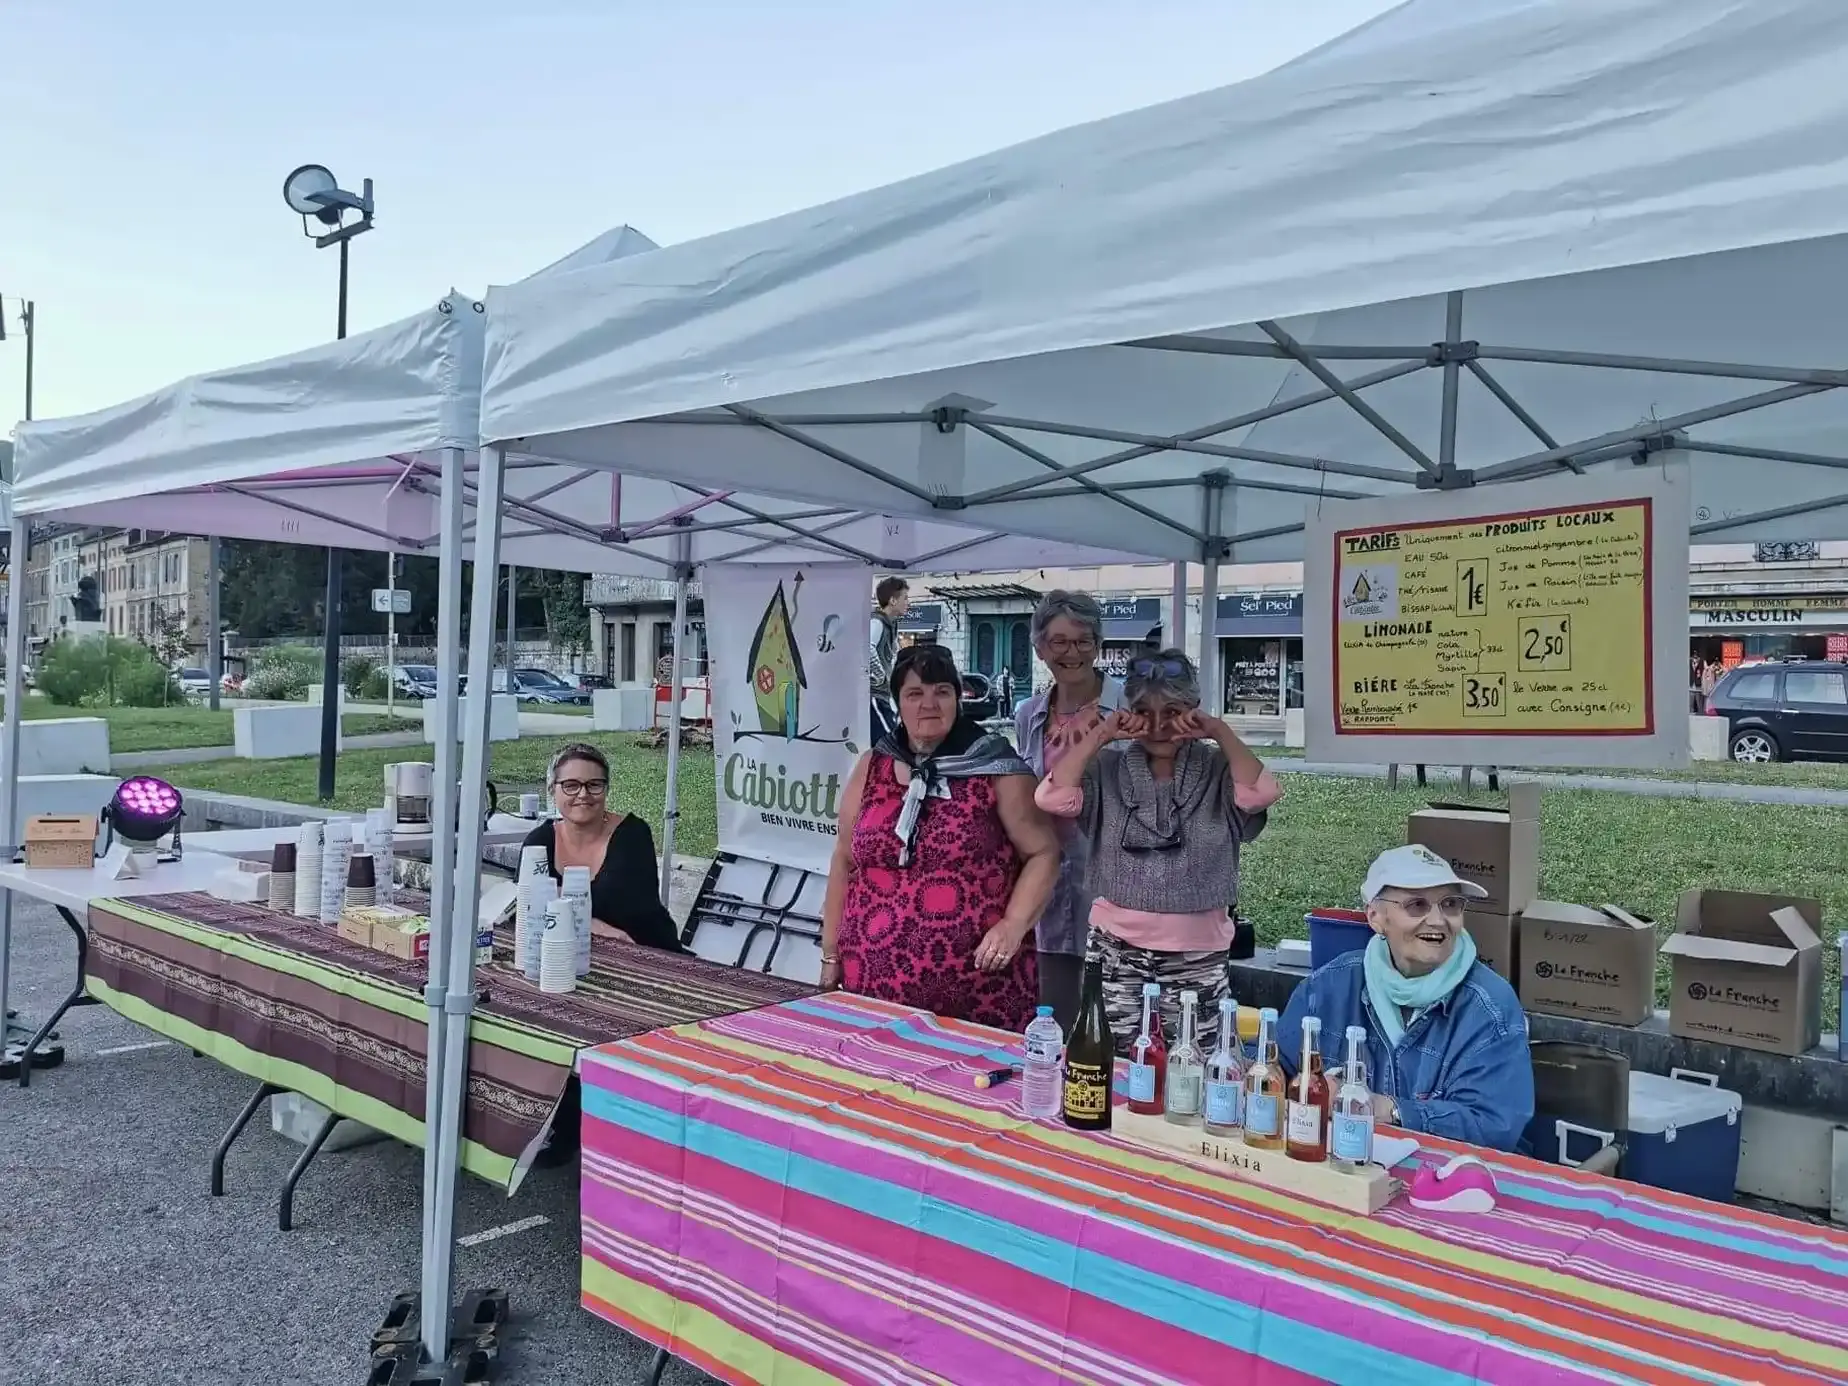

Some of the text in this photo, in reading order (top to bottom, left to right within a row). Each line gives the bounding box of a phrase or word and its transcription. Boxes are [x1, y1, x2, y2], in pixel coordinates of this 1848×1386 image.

[1486, 518, 1546, 537] PRODUITS
[1556, 511, 1615, 528] LOCAUX
[1404, 553, 1425, 562] EAU
[1499, 561, 1518, 572] Jus
[1541, 558, 1577, 568] Pomme
[1404, 567, 1427, 579] CAFÉ
[1499, 580, 1519, 591] Jus
[1113, 604, 1136, 614] Pied
[1266, 600, 1292, 610] Pied
[1708, 609, 1804, 623] MASCULIN
[1364, 620, 1433, 638] LIMONADE
[1437, 641, 1460, 649] Cola
[1517, 704, 1543, 713] avec
[1550, 699, 1607, 716] Consigne
[747, 758, 757, 771] LA
[724, 752, 840, 820] Cabiott
[760, 812, 840, 836] BIEN VIVRE ENS
[1570, 965, 1620, 982] Franche
[1726, 987, 1780, 1007] Franche
[1072, 1069, 1107, 1082] Franche
[1200, 1141, 1261, 1172] Elixia
